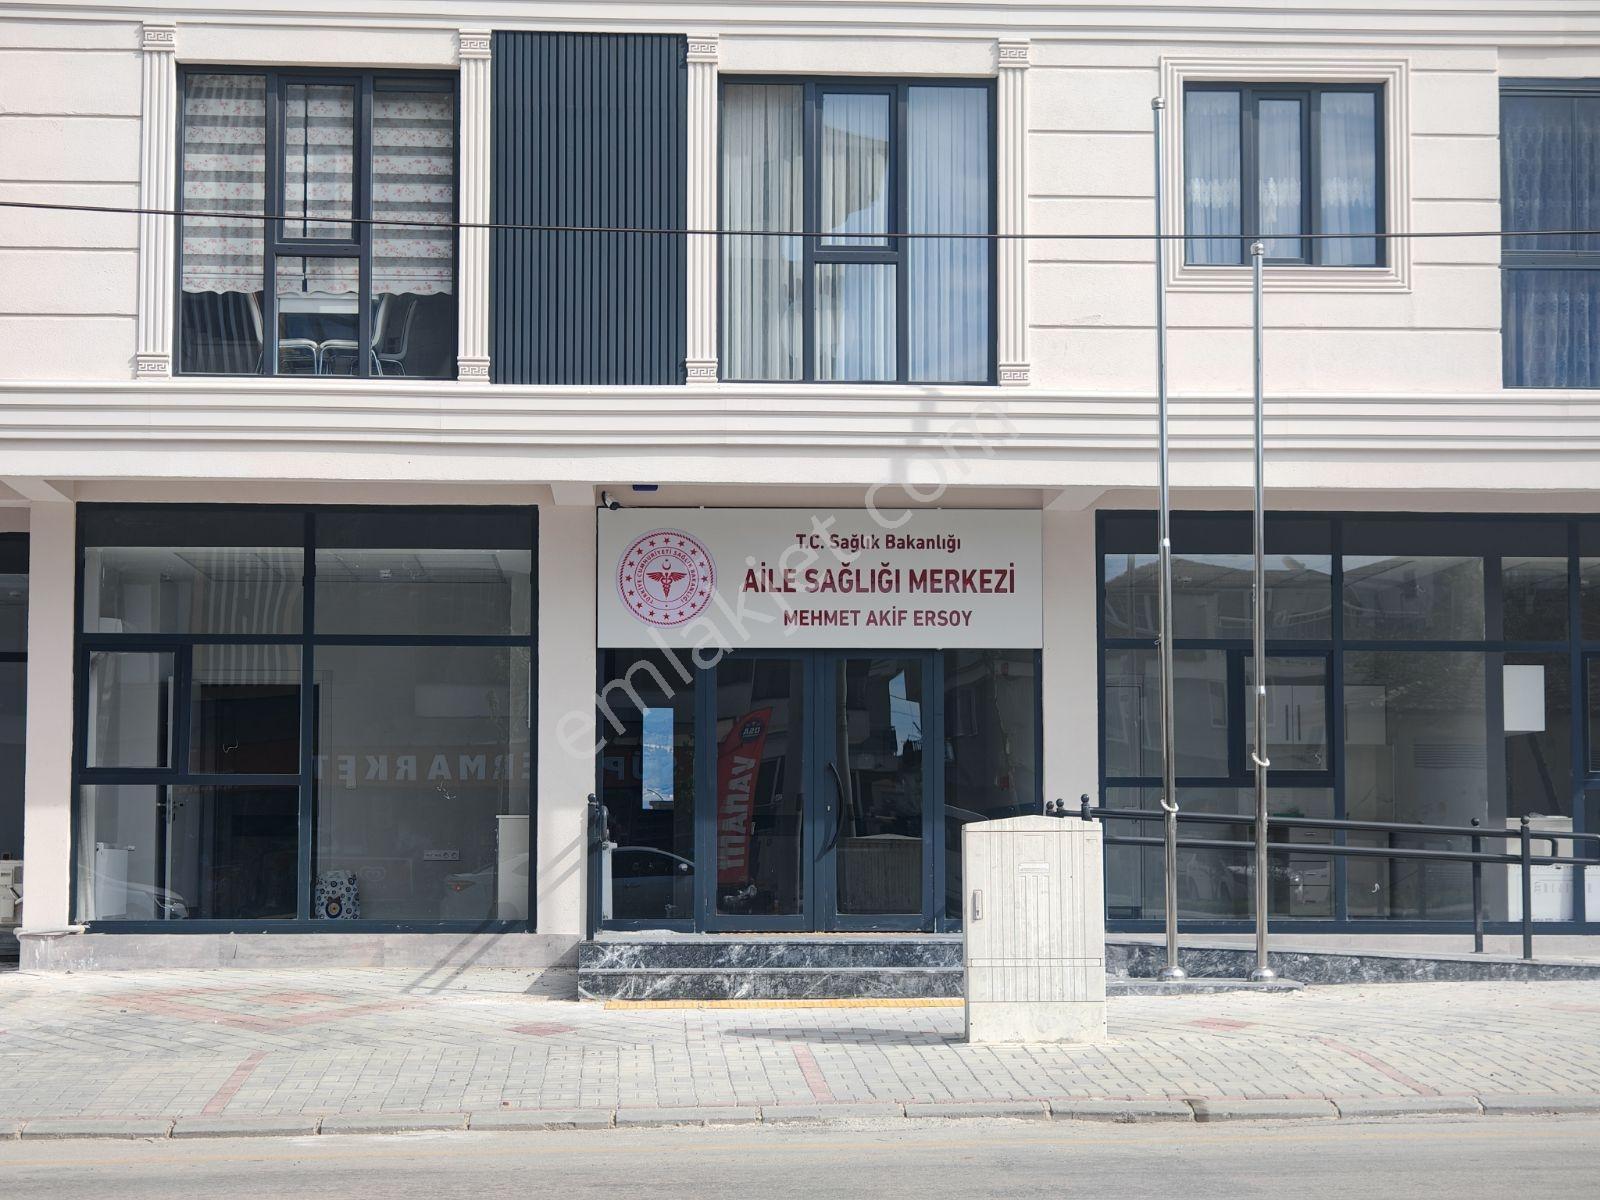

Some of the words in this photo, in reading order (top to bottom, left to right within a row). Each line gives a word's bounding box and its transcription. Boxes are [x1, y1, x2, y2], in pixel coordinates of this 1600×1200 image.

[796, 533, 824, 550] T.C.
[830, 533, 881, 553] Sağlık
[885, 533, 961, 554] Bakanlığı
[742, 562, 797, 593] AİLE
[804, 562, 901, 594] SAĞLIĞI
[909, 562, 1015, 594] MERKEZİ
[783, 609, 861, 627] MEHMET
[866, 605, 908, 627] AKİF
[913, 609, 973, 627] ERSOY
